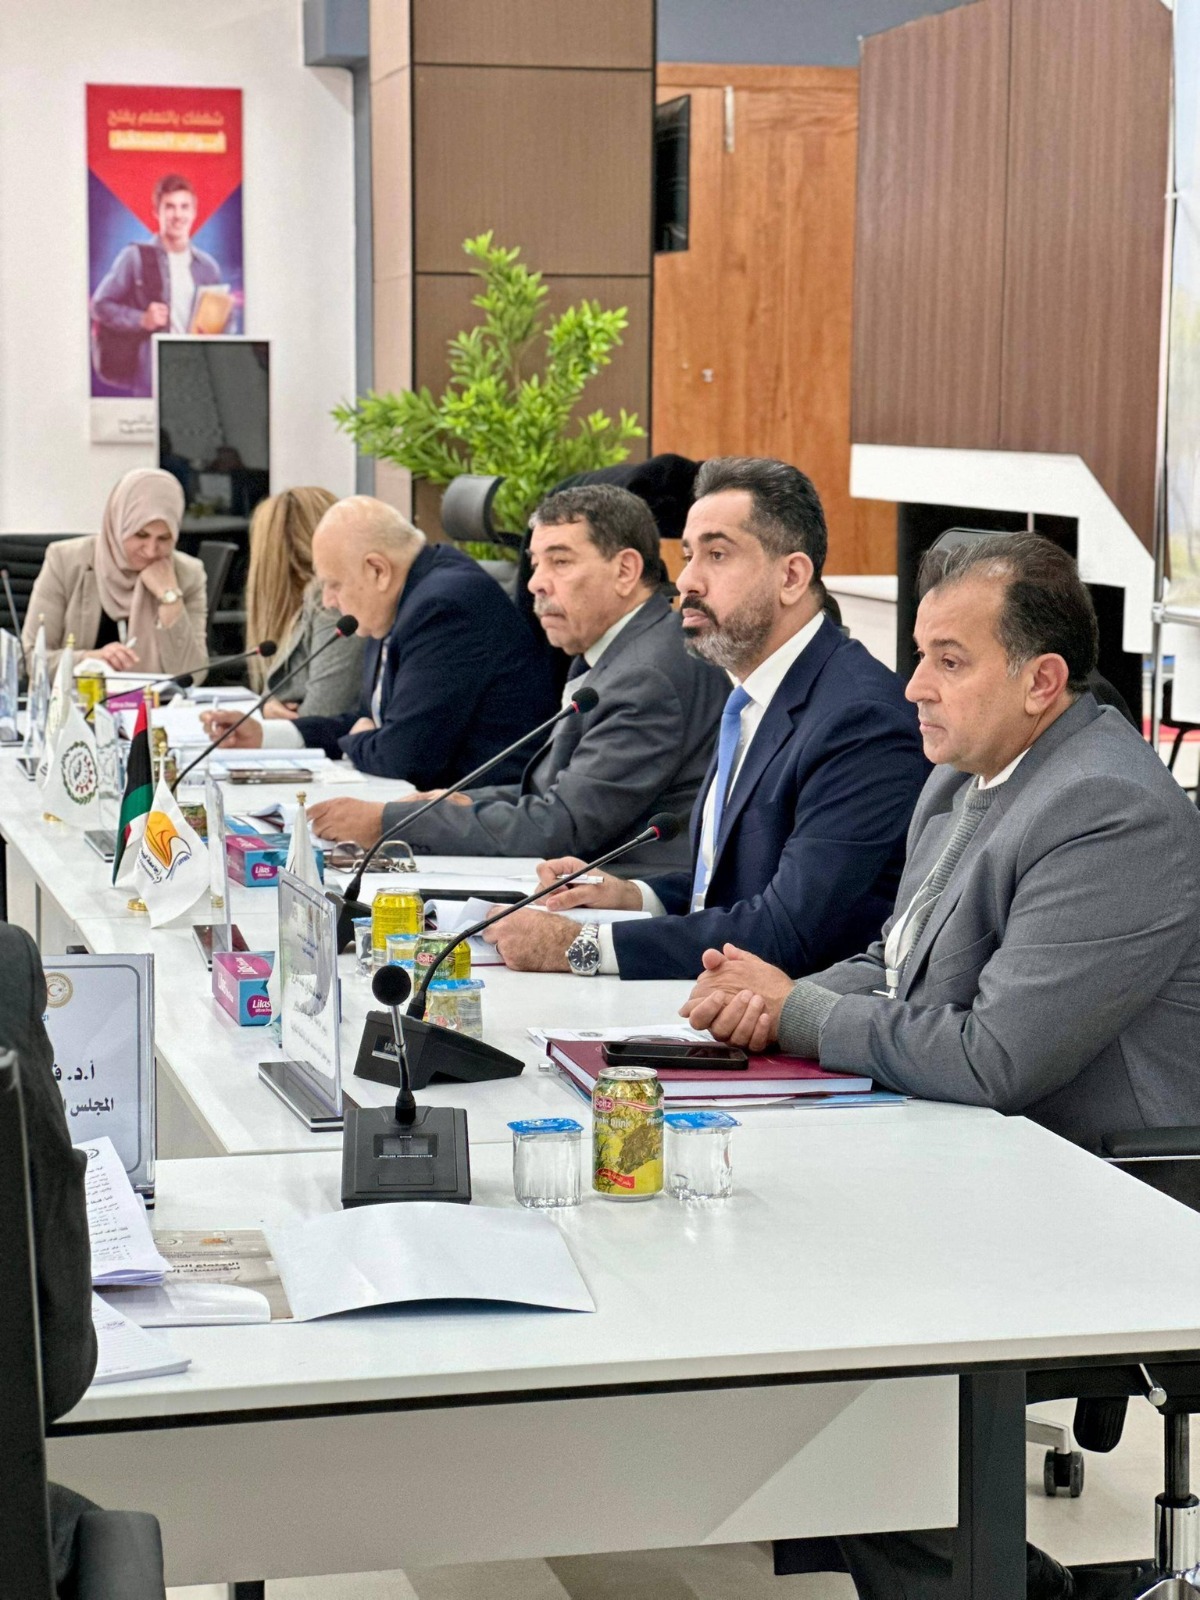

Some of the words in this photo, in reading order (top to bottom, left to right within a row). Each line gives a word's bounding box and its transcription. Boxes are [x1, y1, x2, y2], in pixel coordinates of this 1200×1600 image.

[252, 999, 271, 1009] Lilas
[70, 1097, 114, 1117] المجلس
[610, 1117, 631, 1128] Drink
